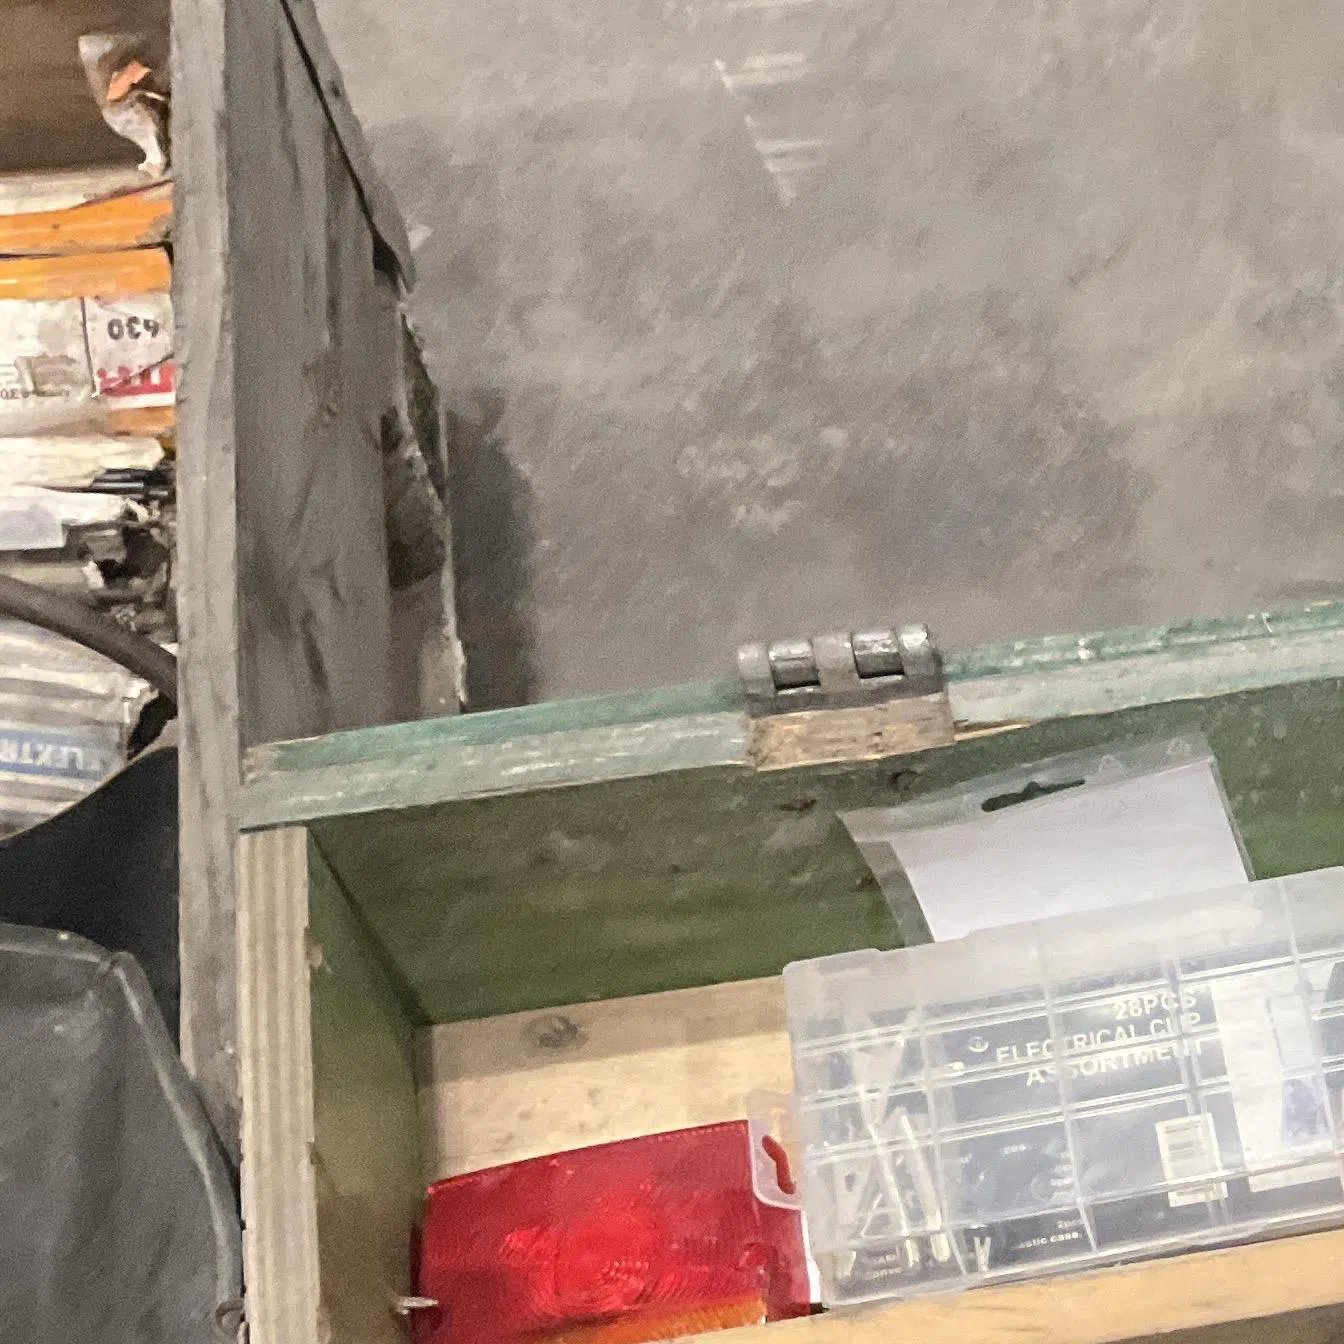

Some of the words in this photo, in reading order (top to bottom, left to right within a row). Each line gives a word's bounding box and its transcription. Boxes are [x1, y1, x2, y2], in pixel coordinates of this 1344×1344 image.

[1114, 986, 1197, 1021] 28PCS
[995, 1023, 1138, 1064] ELECTRICAL
[1025, 1038, 1203, 1088] ASSORTMENT
